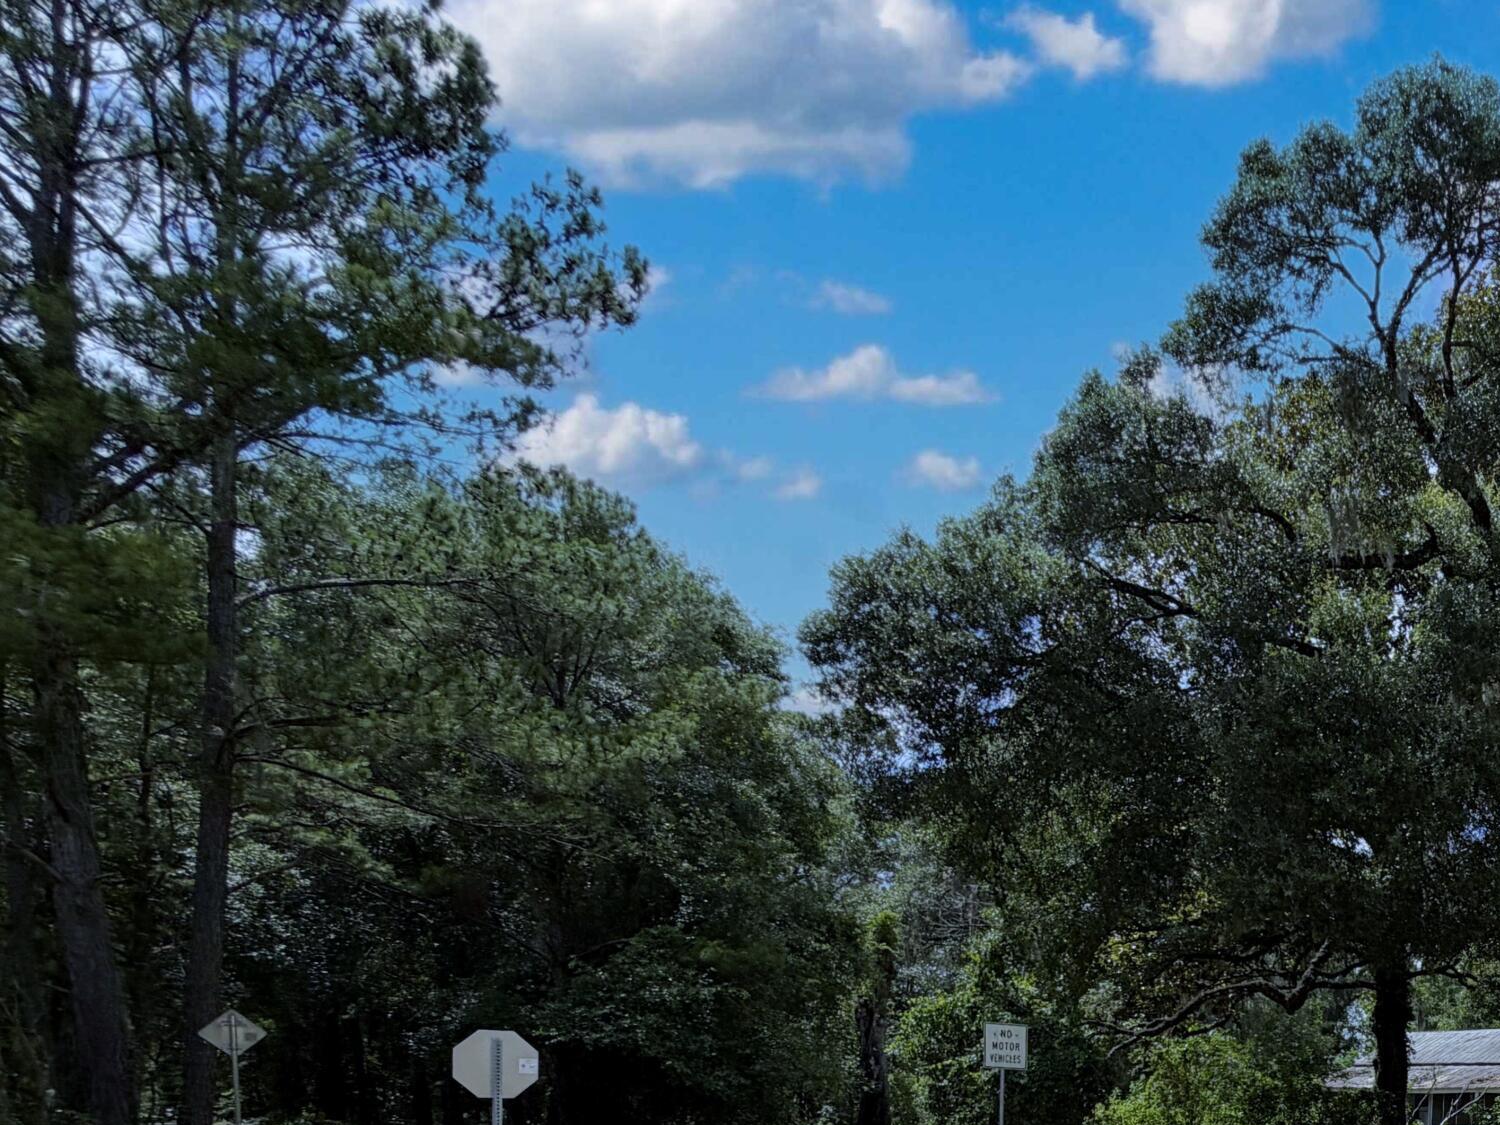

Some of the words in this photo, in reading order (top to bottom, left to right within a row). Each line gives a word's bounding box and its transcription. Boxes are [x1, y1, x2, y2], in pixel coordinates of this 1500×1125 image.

[1000, 1029, 1013, 1039] NO
[992, 1041, 1020, 1051] MOTOR
[990, 1053, 1021, 1064] VEHICLES
